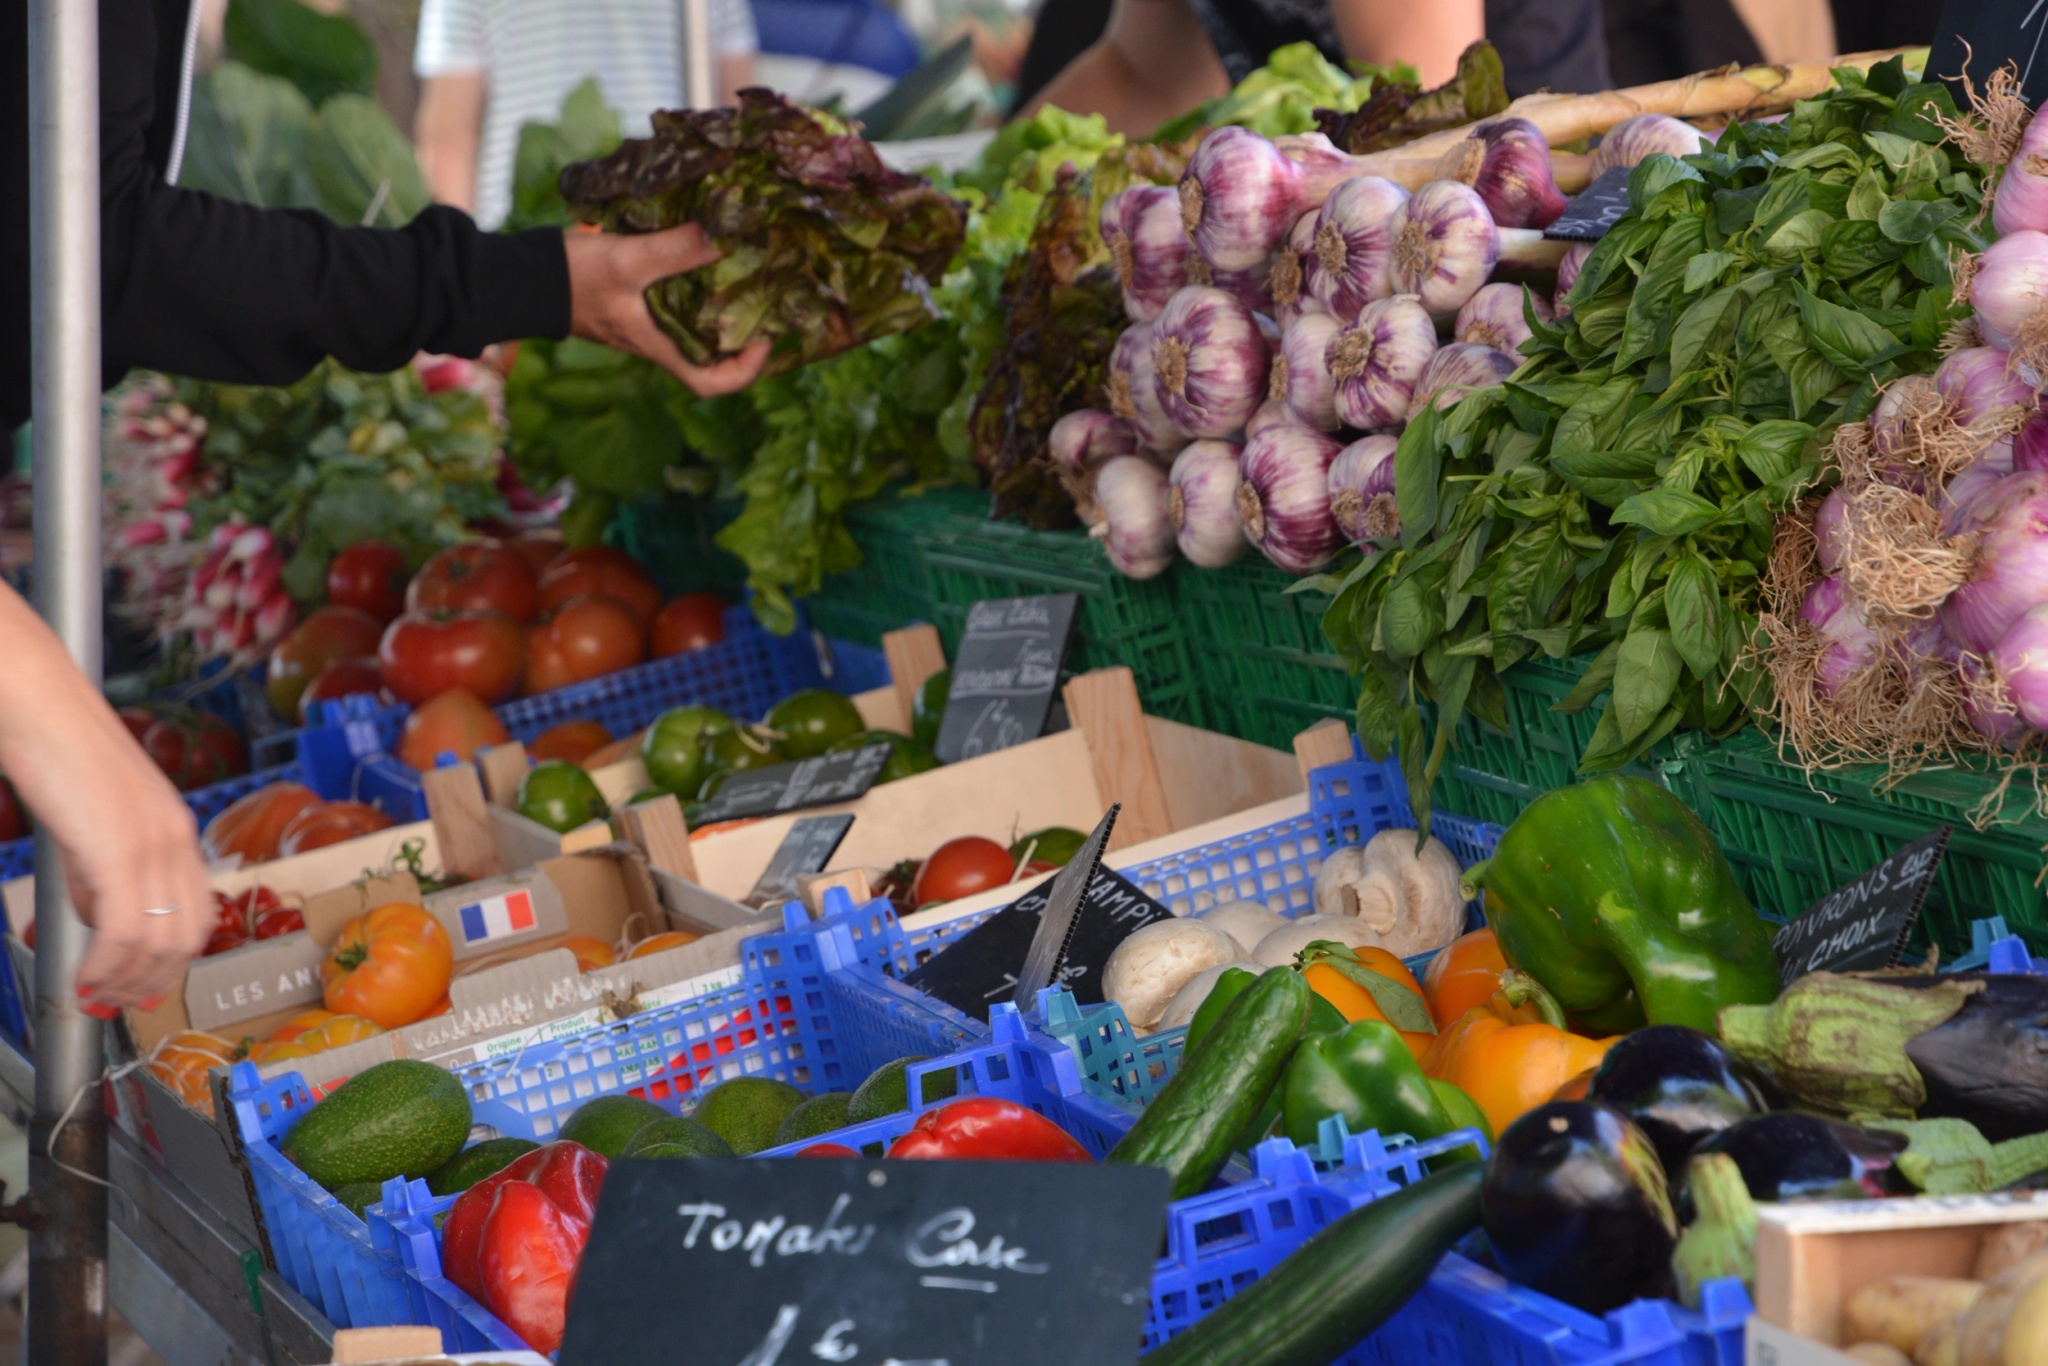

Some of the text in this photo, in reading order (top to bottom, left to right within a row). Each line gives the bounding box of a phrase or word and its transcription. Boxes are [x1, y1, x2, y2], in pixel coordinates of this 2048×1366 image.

[215, 980, 265, 1011] LES
[549, 1015, 586, 1034] Produit
[486, 1033, 523, 1054] Origine
